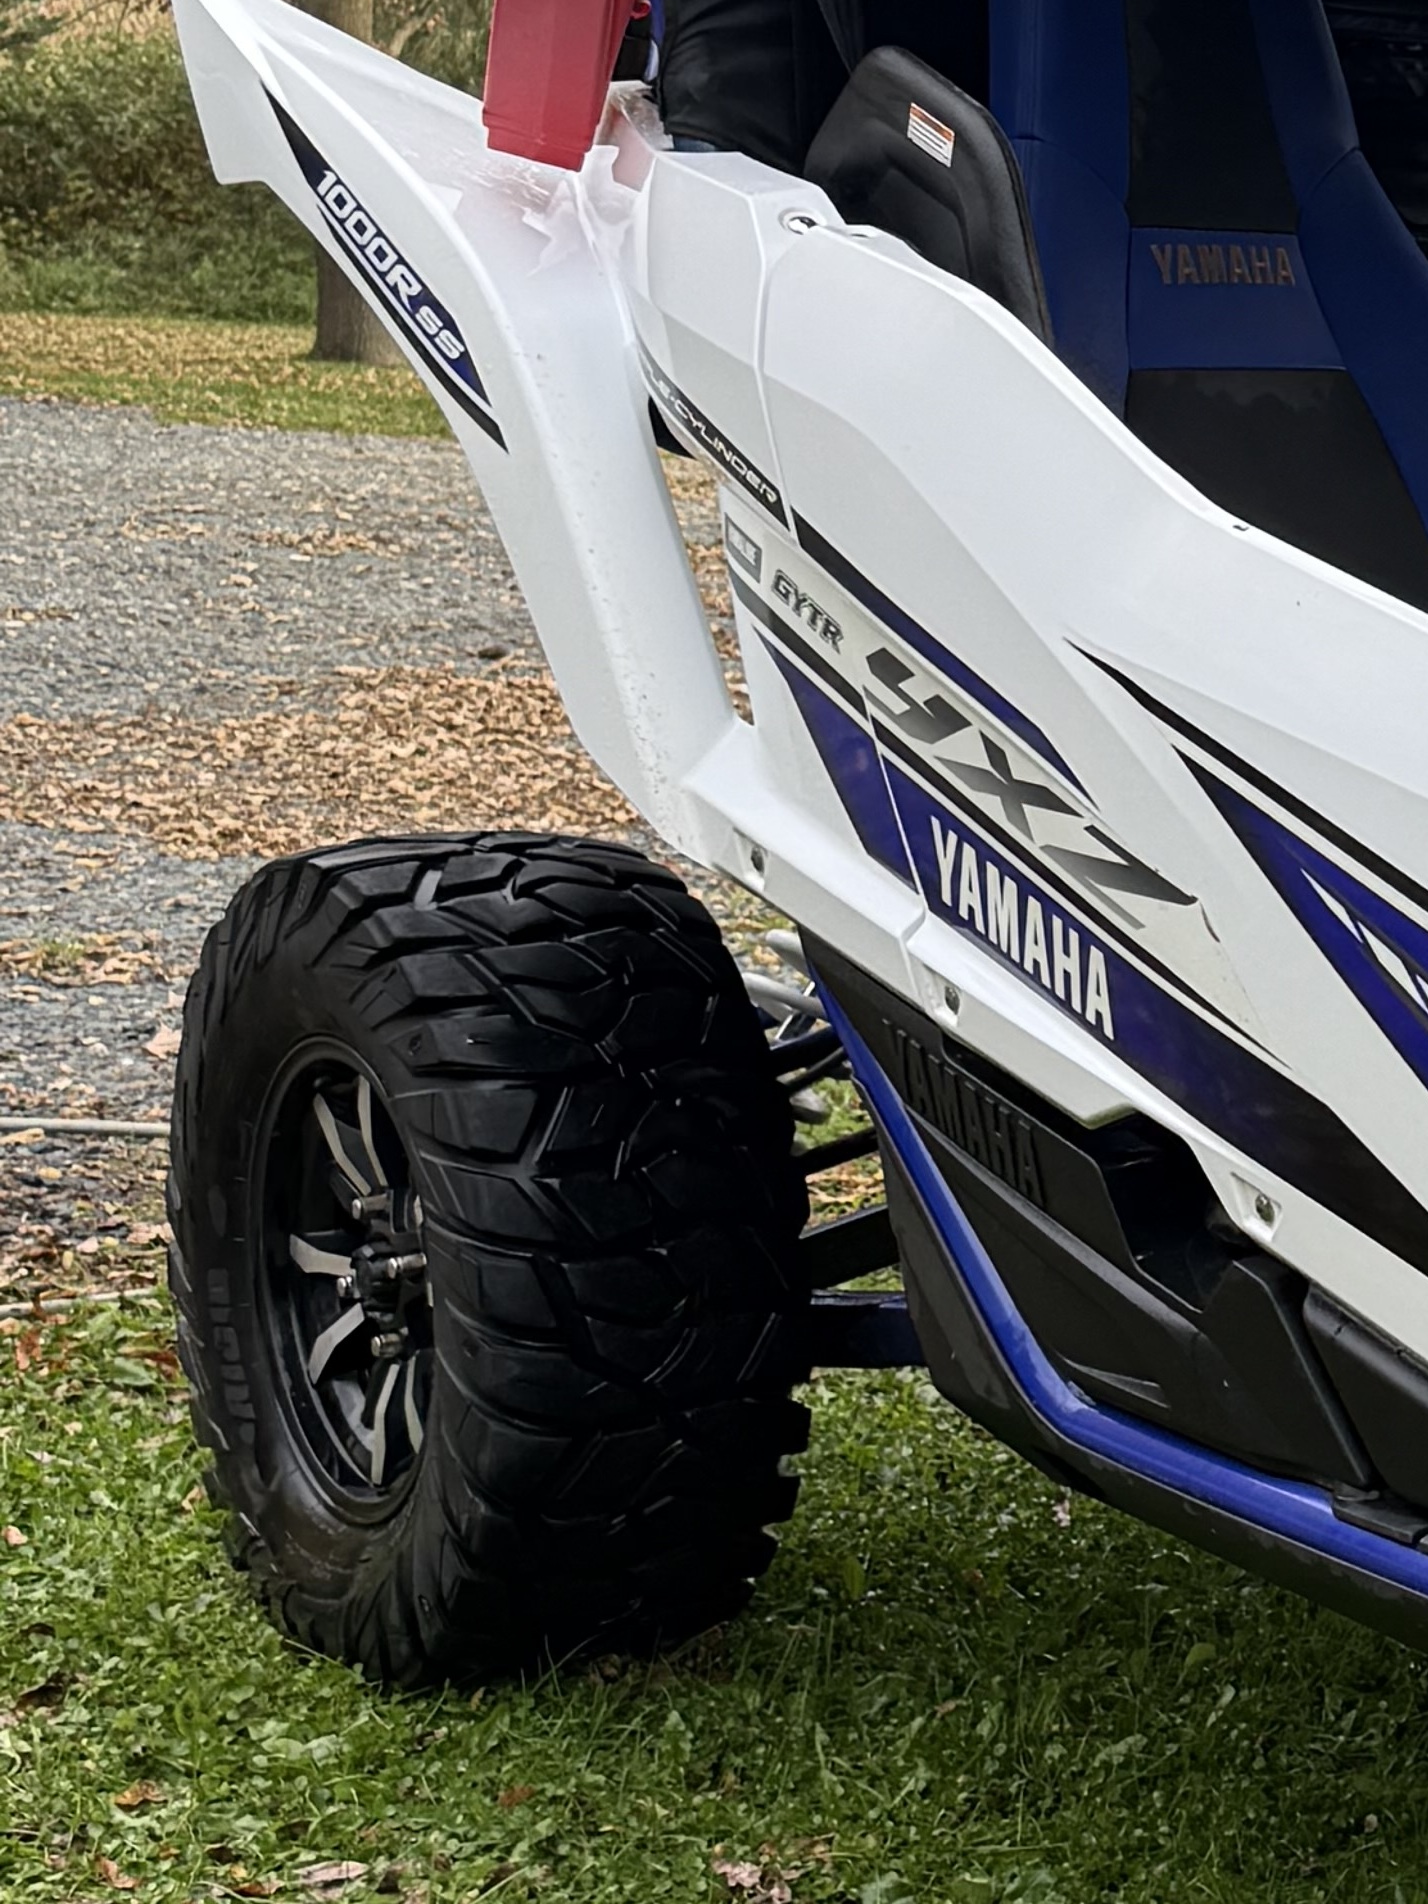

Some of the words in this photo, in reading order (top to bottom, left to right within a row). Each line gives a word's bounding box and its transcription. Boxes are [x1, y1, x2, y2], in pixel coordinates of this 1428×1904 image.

[315, 169, 424, 311] 1000R
[415, 303, 465, 361] SS
[1149, 242, 1297, 288] YAMAHA
[771, 568, 845, 654] GYTR
[929, 815, 1117, 1042] YAMAHA
[881, 1017, 1046, 1209] YAMAHA
